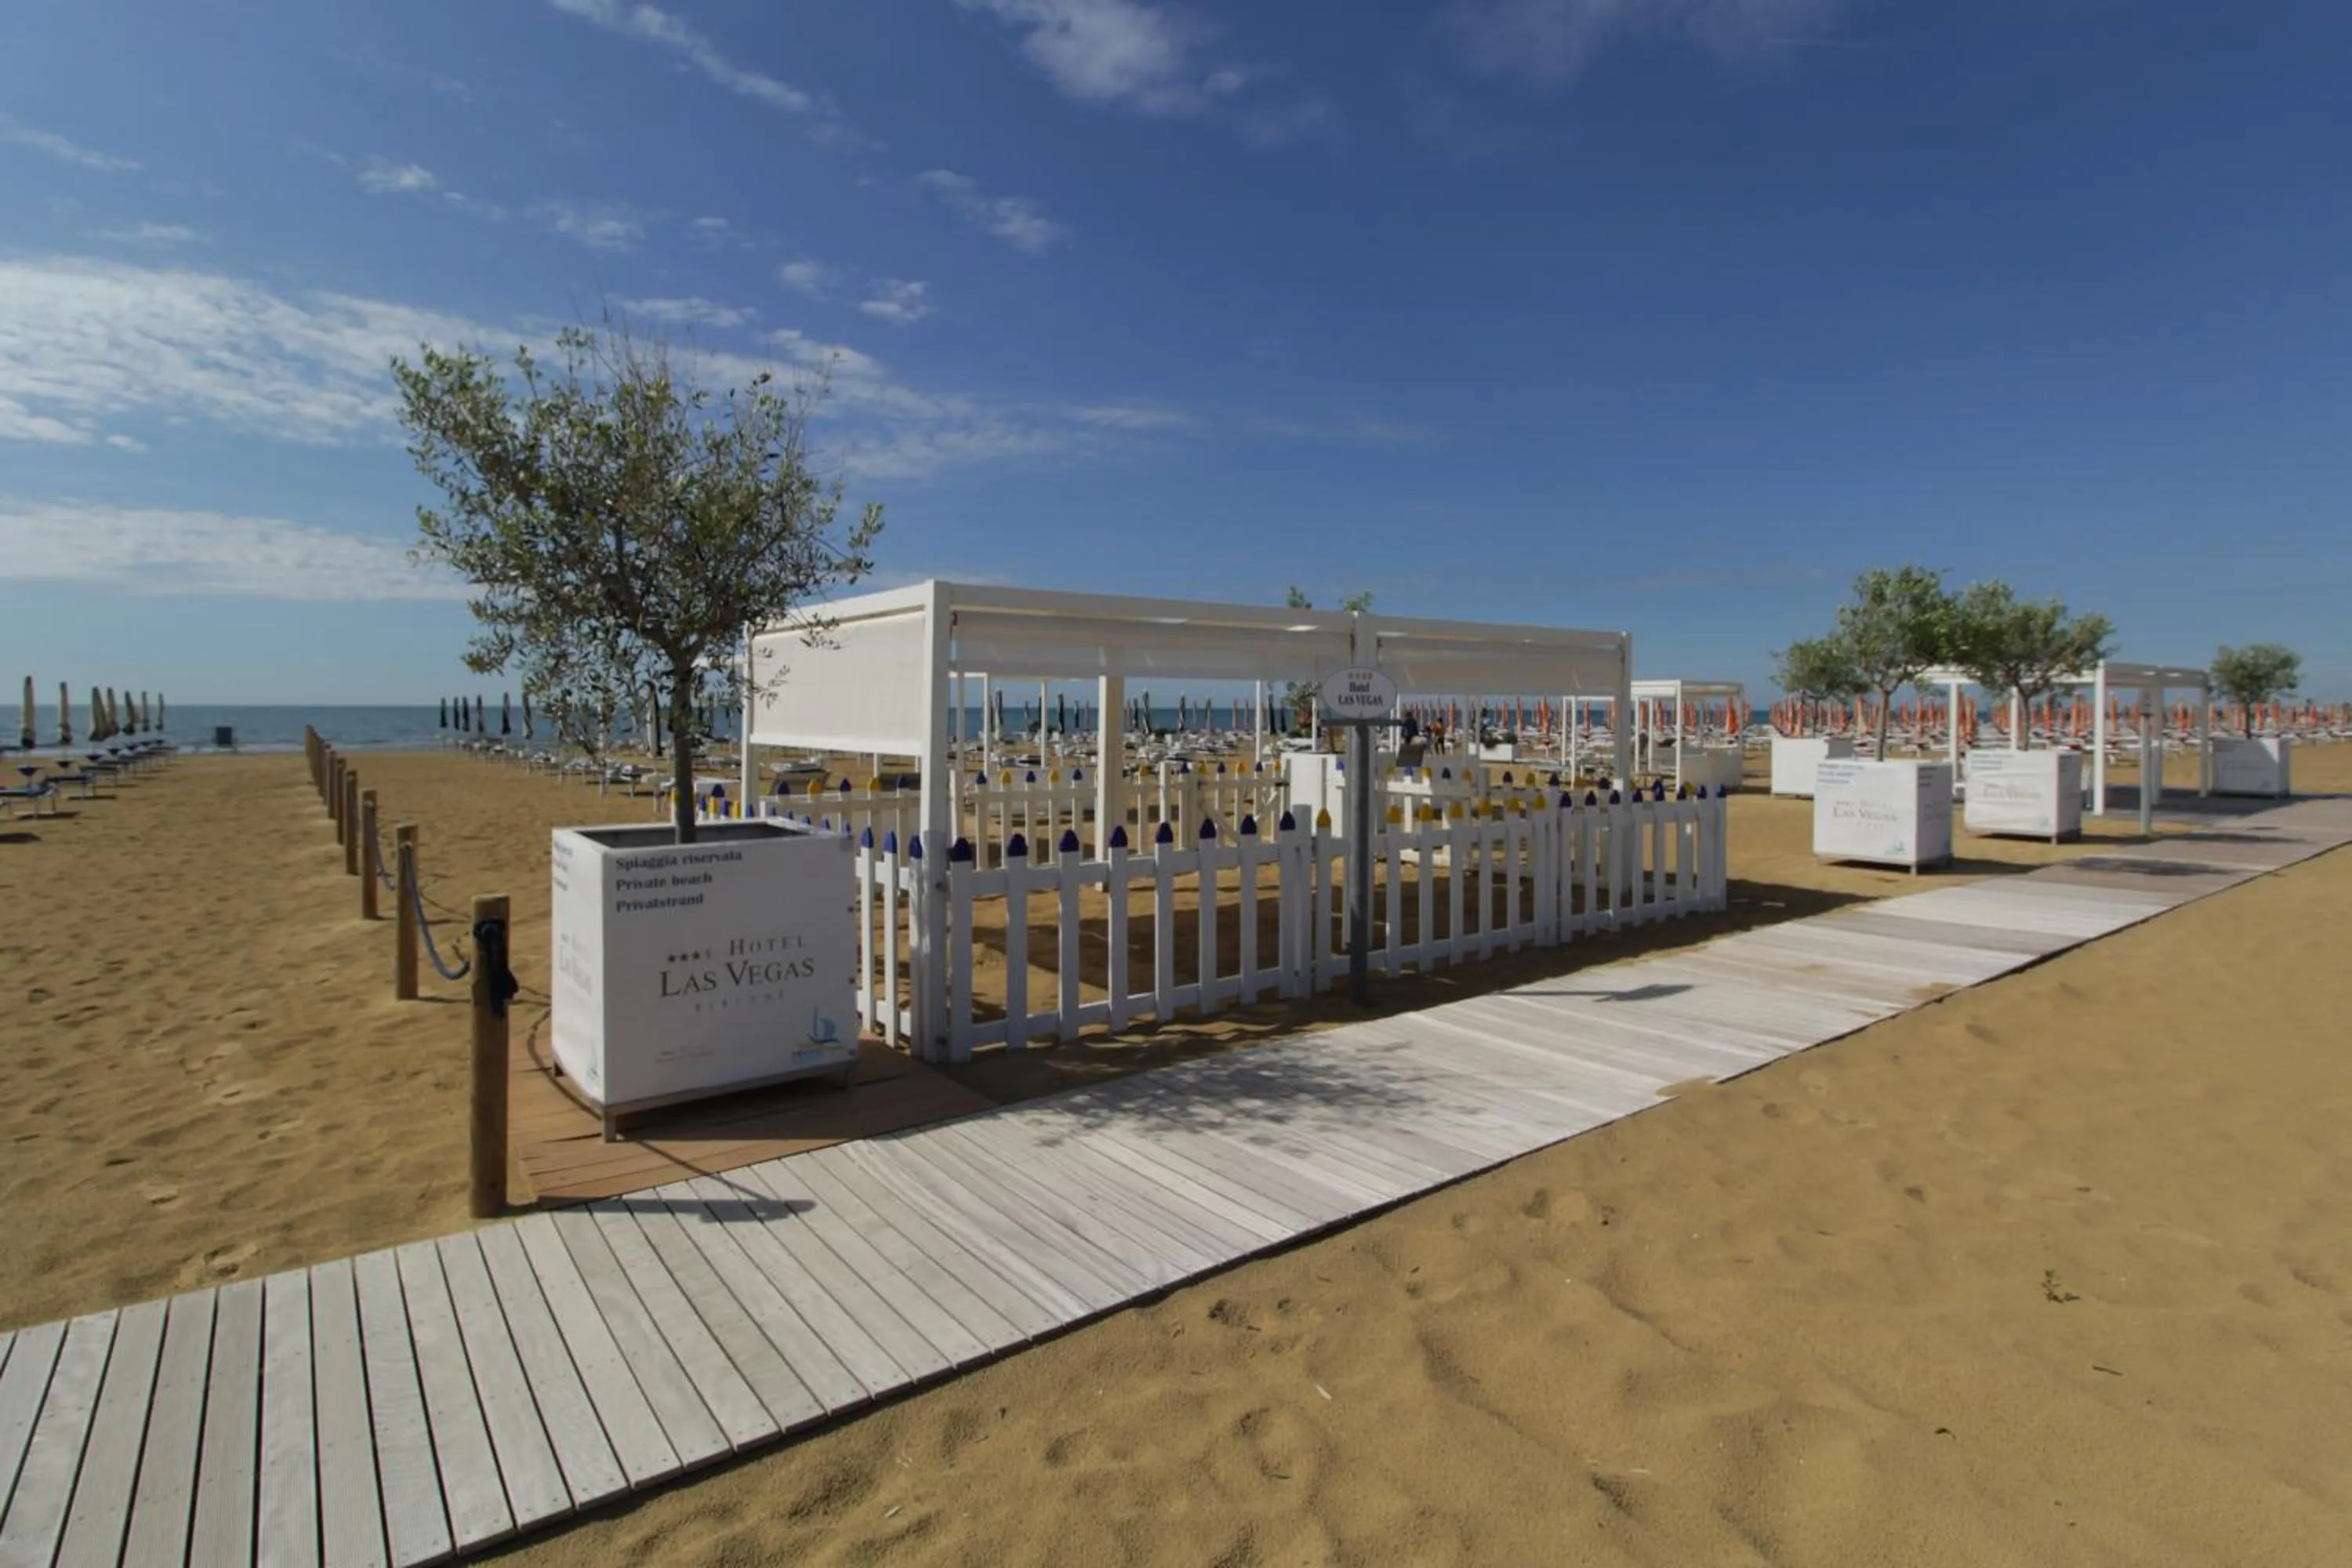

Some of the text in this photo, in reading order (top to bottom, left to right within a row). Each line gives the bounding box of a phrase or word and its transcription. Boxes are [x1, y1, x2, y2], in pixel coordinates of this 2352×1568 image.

[1338, 694, 1383, 706] LAS VEGAS
[615, 851, 742, 872] Spiaggia riservata
[615, 872, 713, 891] Private beach
[615, 892, 704, 913] Privatstrand
[729, 935, 807, 956] HOTEL
[659, 956, 815, 998] LAS VEGAS
